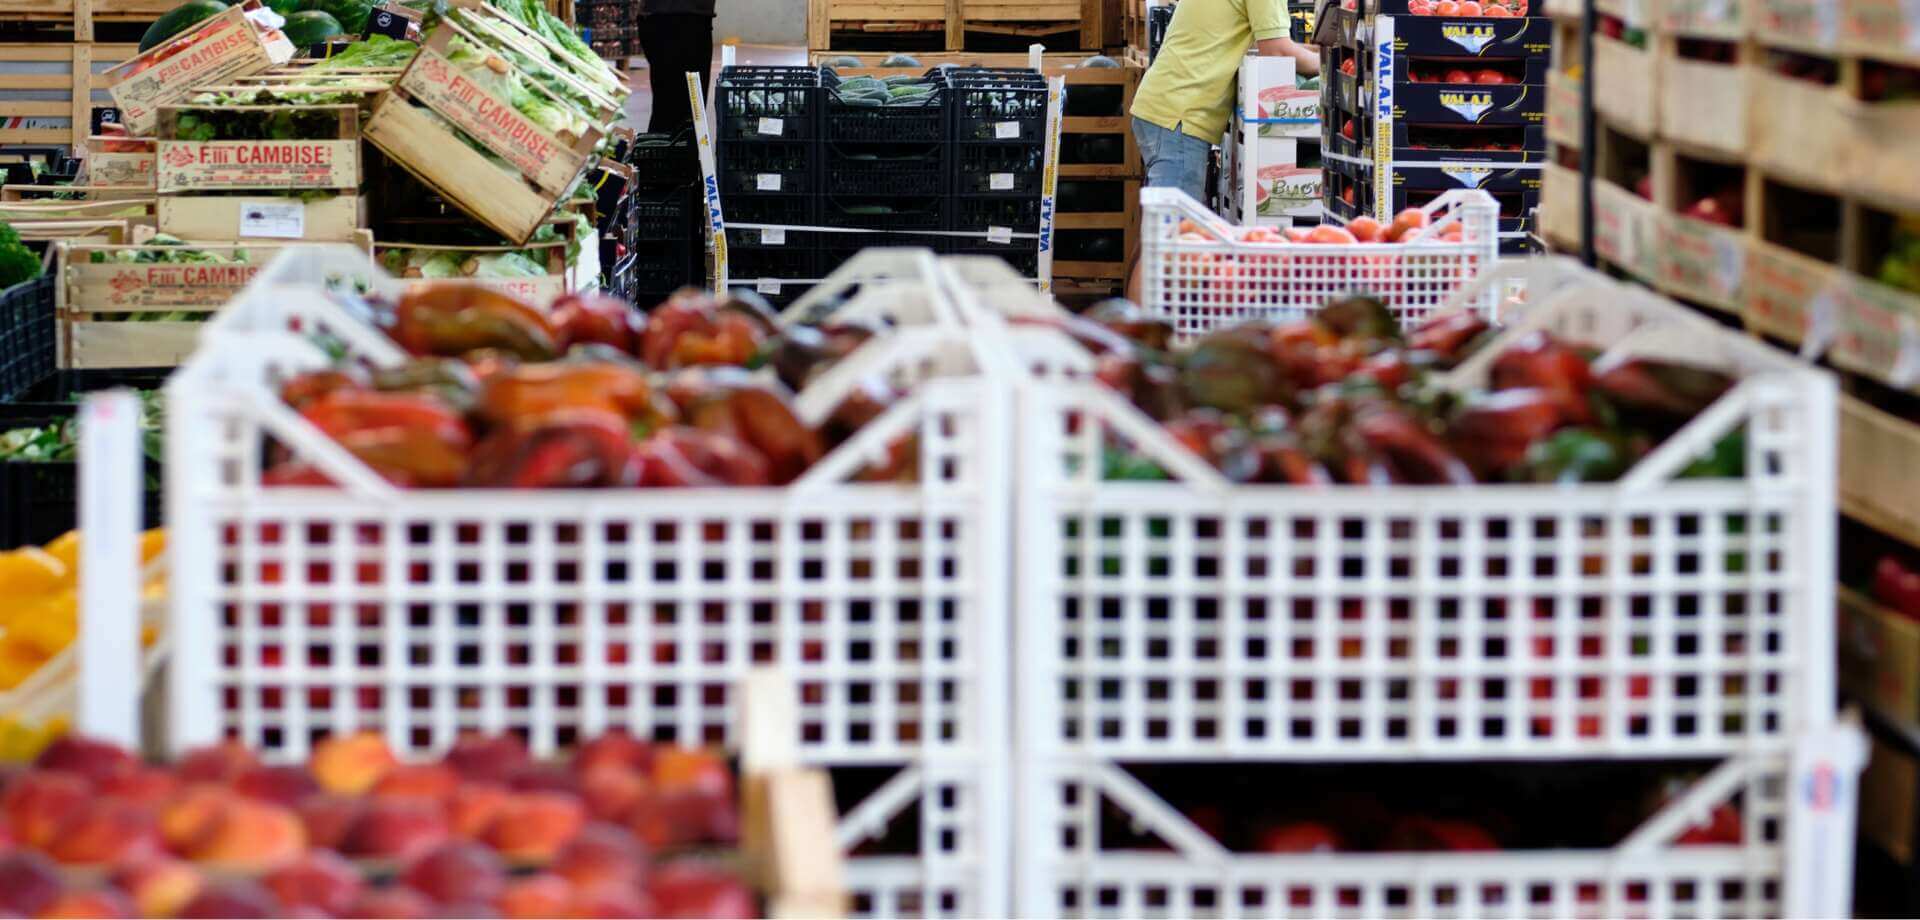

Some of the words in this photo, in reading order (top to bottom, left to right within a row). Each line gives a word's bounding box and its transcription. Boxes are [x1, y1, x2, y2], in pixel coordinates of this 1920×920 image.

[179, 28, 249, 71] CAMBISE
[1379, 41, 1392, 119] VAL.A.F.
[236, 145, 326, 165] CAMBISE
[477, 96, 552, 161] CAMBISE
[705, 175, 723, 233] VAL.A.F.
[1040, 197, 1052, 252] VAL.A.F.
